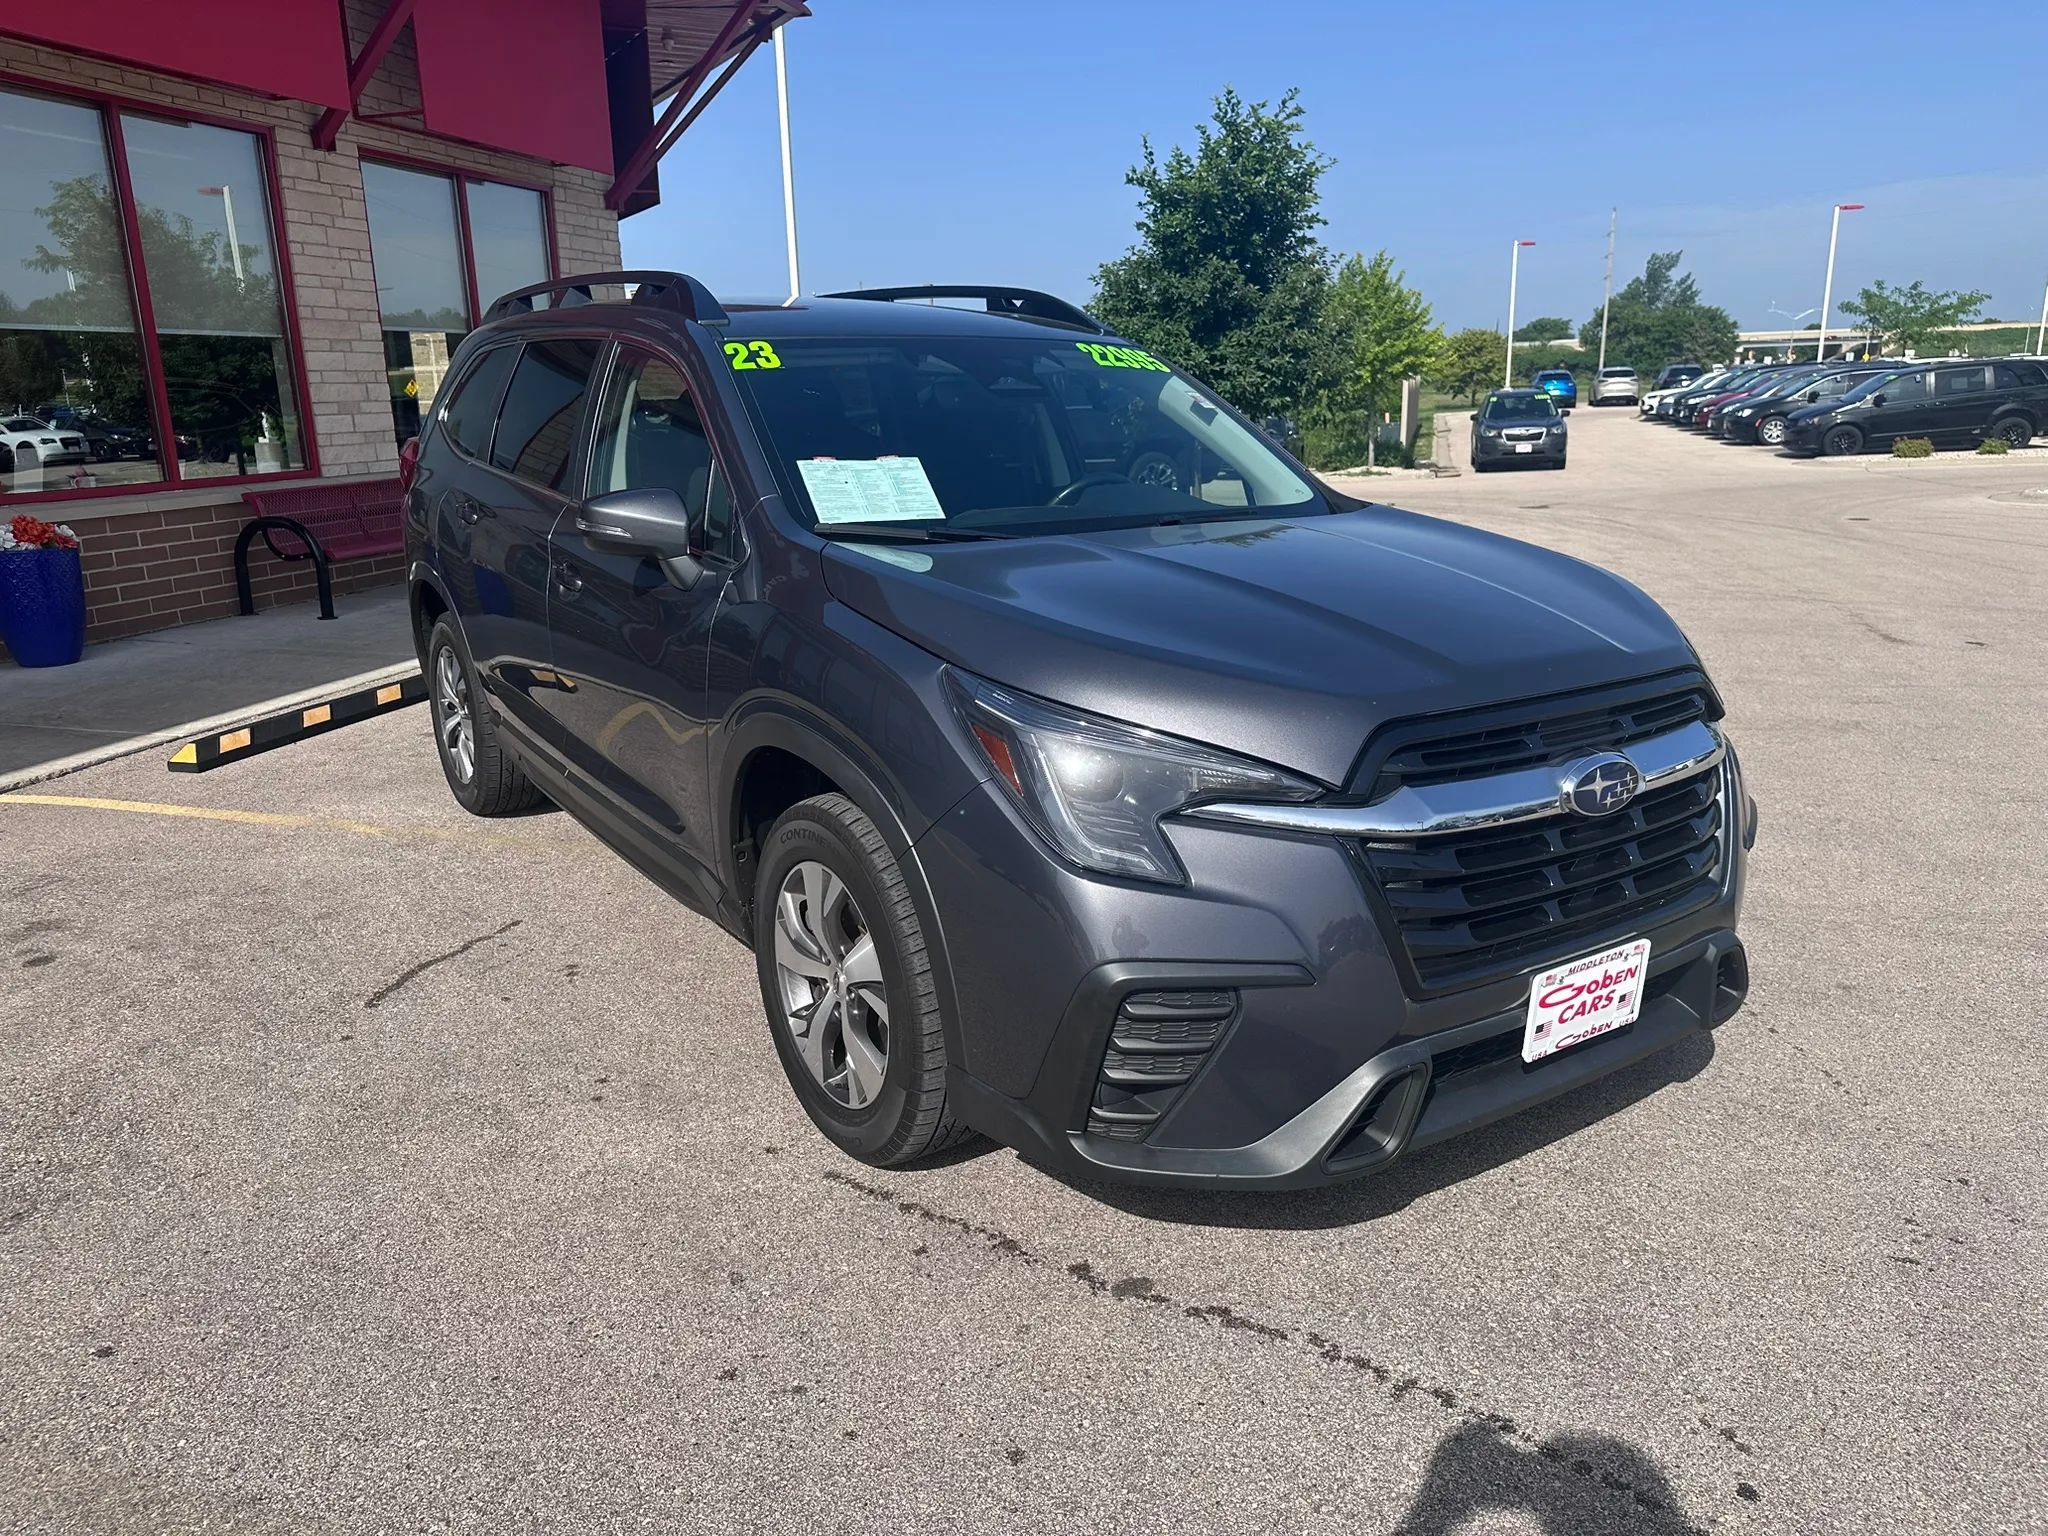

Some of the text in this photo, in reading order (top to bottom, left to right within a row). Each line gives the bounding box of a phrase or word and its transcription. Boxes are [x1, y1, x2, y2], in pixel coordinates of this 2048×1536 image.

[723, 340, 782, 370] 23
[1075, 341, 1172, 374] 22995
[1568, 949, 1625, 975] MIDDLETON
[1557, 988, 1617, 1025] CARS
